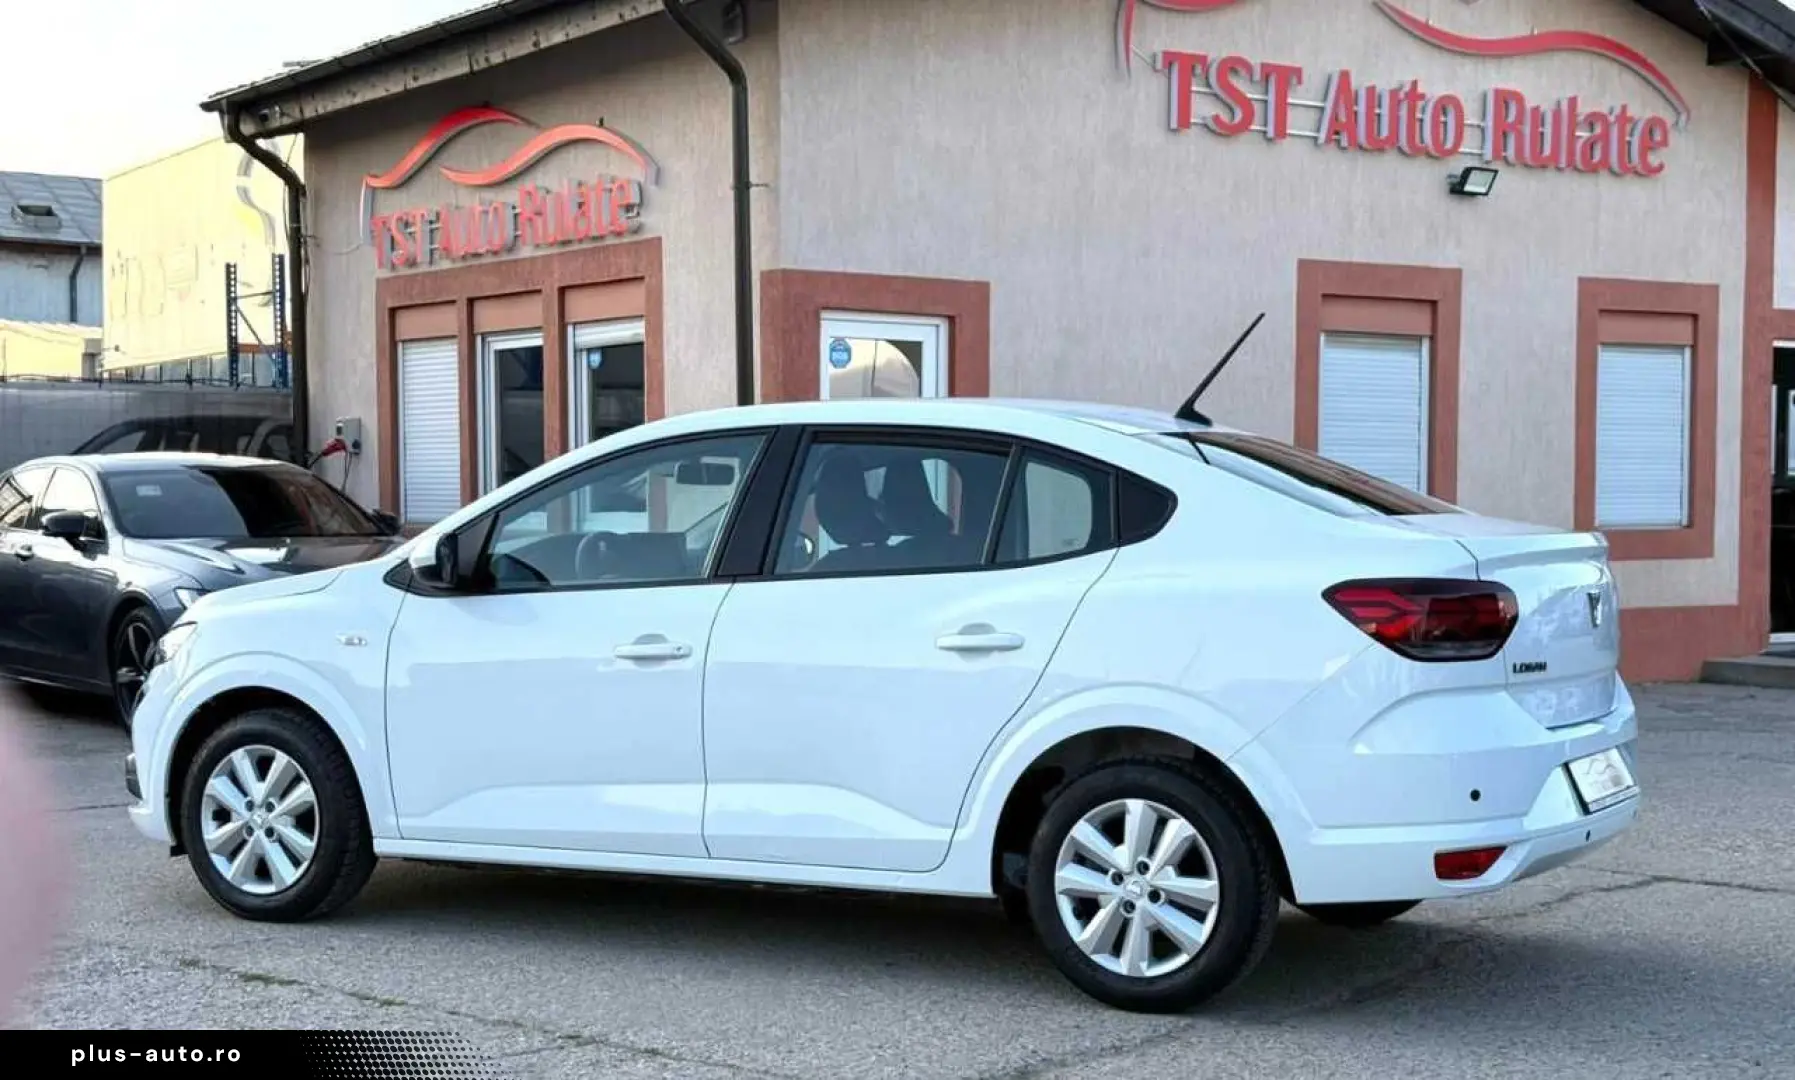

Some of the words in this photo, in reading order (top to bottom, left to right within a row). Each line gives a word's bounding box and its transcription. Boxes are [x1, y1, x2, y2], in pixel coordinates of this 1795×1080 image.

[1157, 50, 1302, 140] TST
[1318, 69, 1463, 157] Auto
[1483, 86, 1669, 176] Rulate
[371, 208, 430, 269] TST
[440, 202, 514, 259] Auto
[518, 178, 640, 246] Rulate
